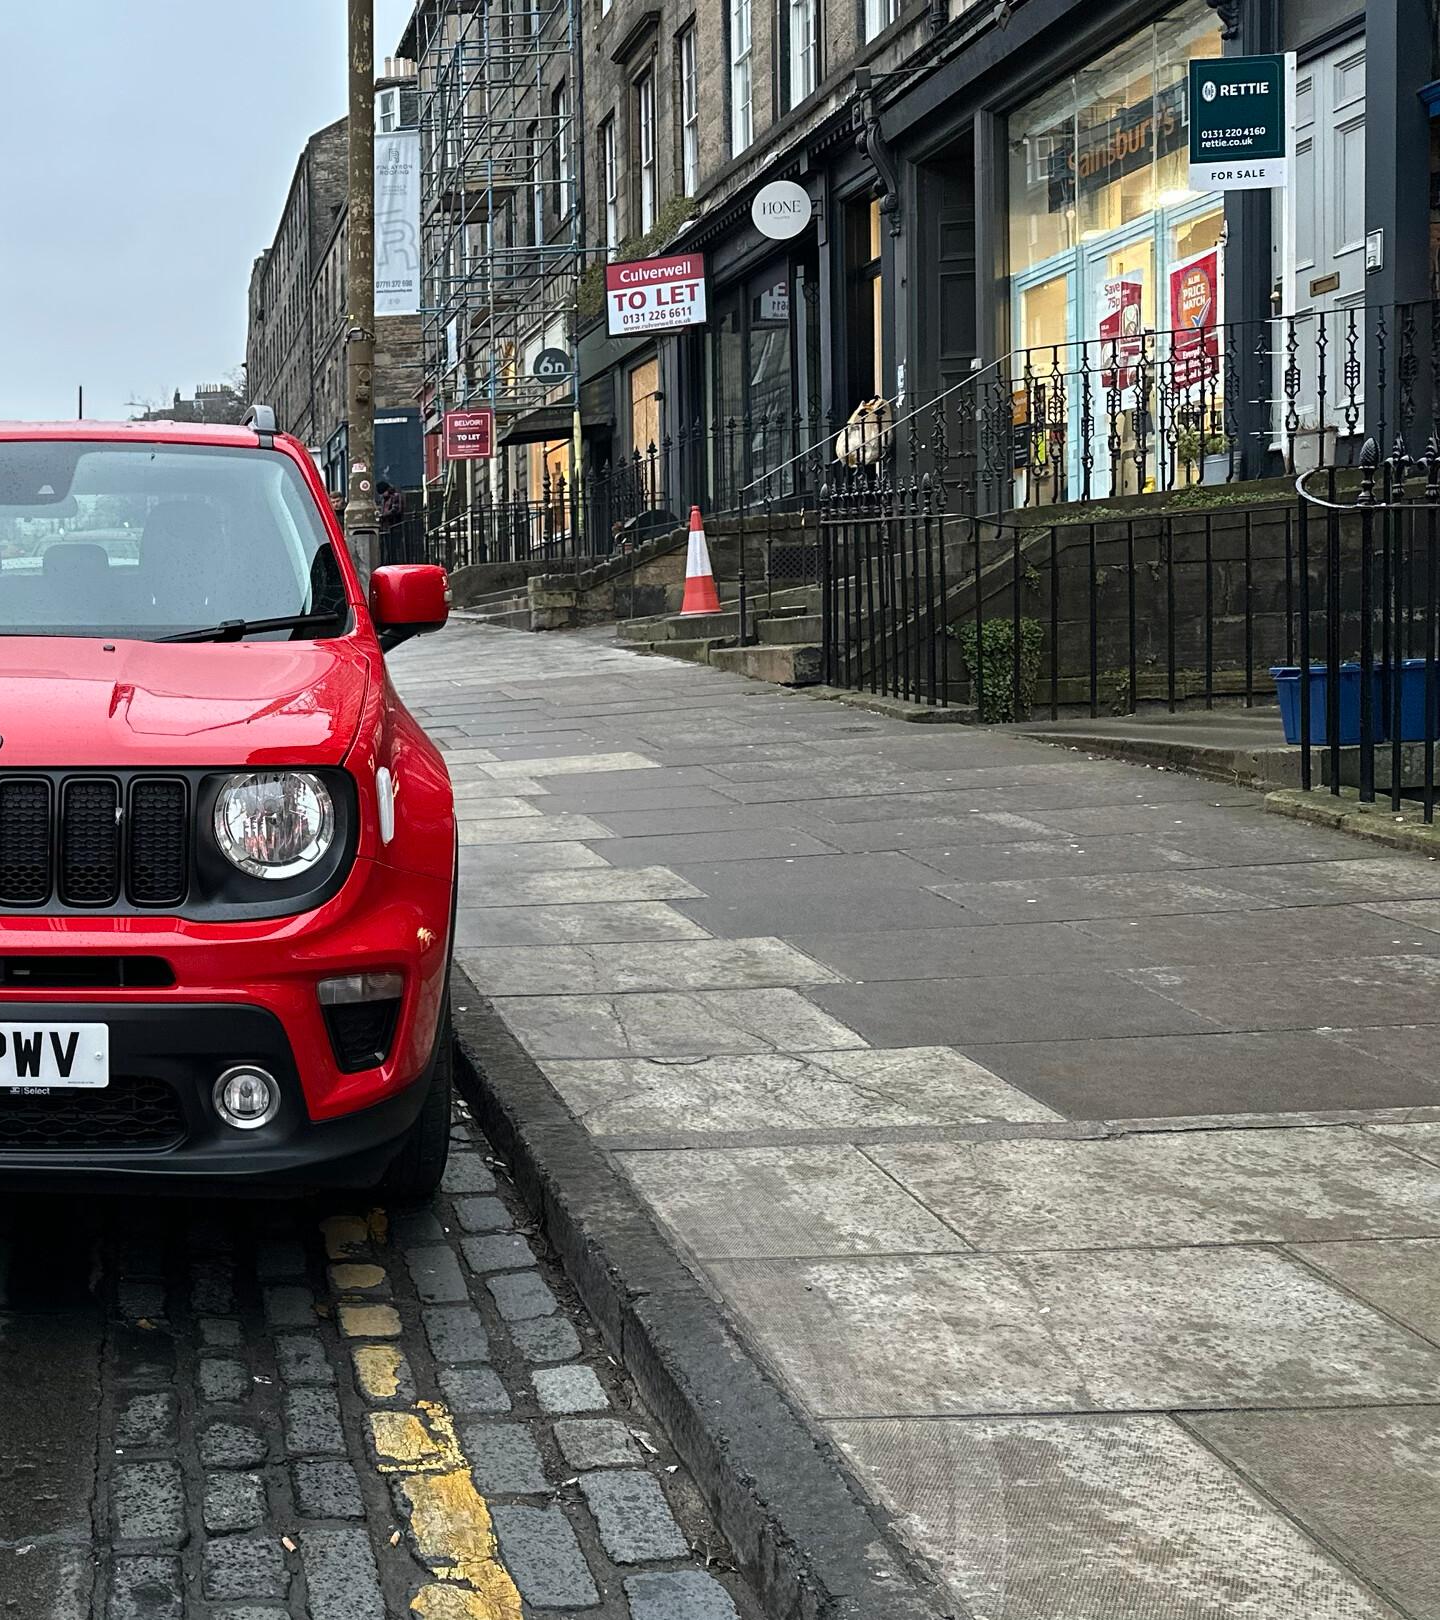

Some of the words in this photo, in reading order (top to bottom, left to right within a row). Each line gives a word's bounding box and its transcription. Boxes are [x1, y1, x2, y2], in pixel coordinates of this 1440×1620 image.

[1220, 82, 1269, 97] RETTIE
[1202, 130, 1224, 139] 0131
[1225, 128, 1242, 138] 220
[1243, 127, 1266, 136] 4160
[1201, 137, 1253, 148] rettie.co.uk
[1211, 171, 1233, 181] FOR
[1237, 169, 1265, 179] SALE
[762, 200, 801, 215] HONE
[620, 261, 691, 283] Culverwell
[1104, 281, 1120, 296] Save
[1183, 282, 1205, 300] PRICE
[613, 291, 647, 312] TO
[656, 283, 700, 307] LET
[1108, 297, 1120, 310] 75p
[1183, 295, 1206, 310] MATCH
[623, 313, 645, 325] 0131
[649, 310, 666, 321] 226
[669, 306, 692, 318] 6611
[454, 419, 483, 427] BELVOIR!
[24, 1086, 50, 1095] Select
